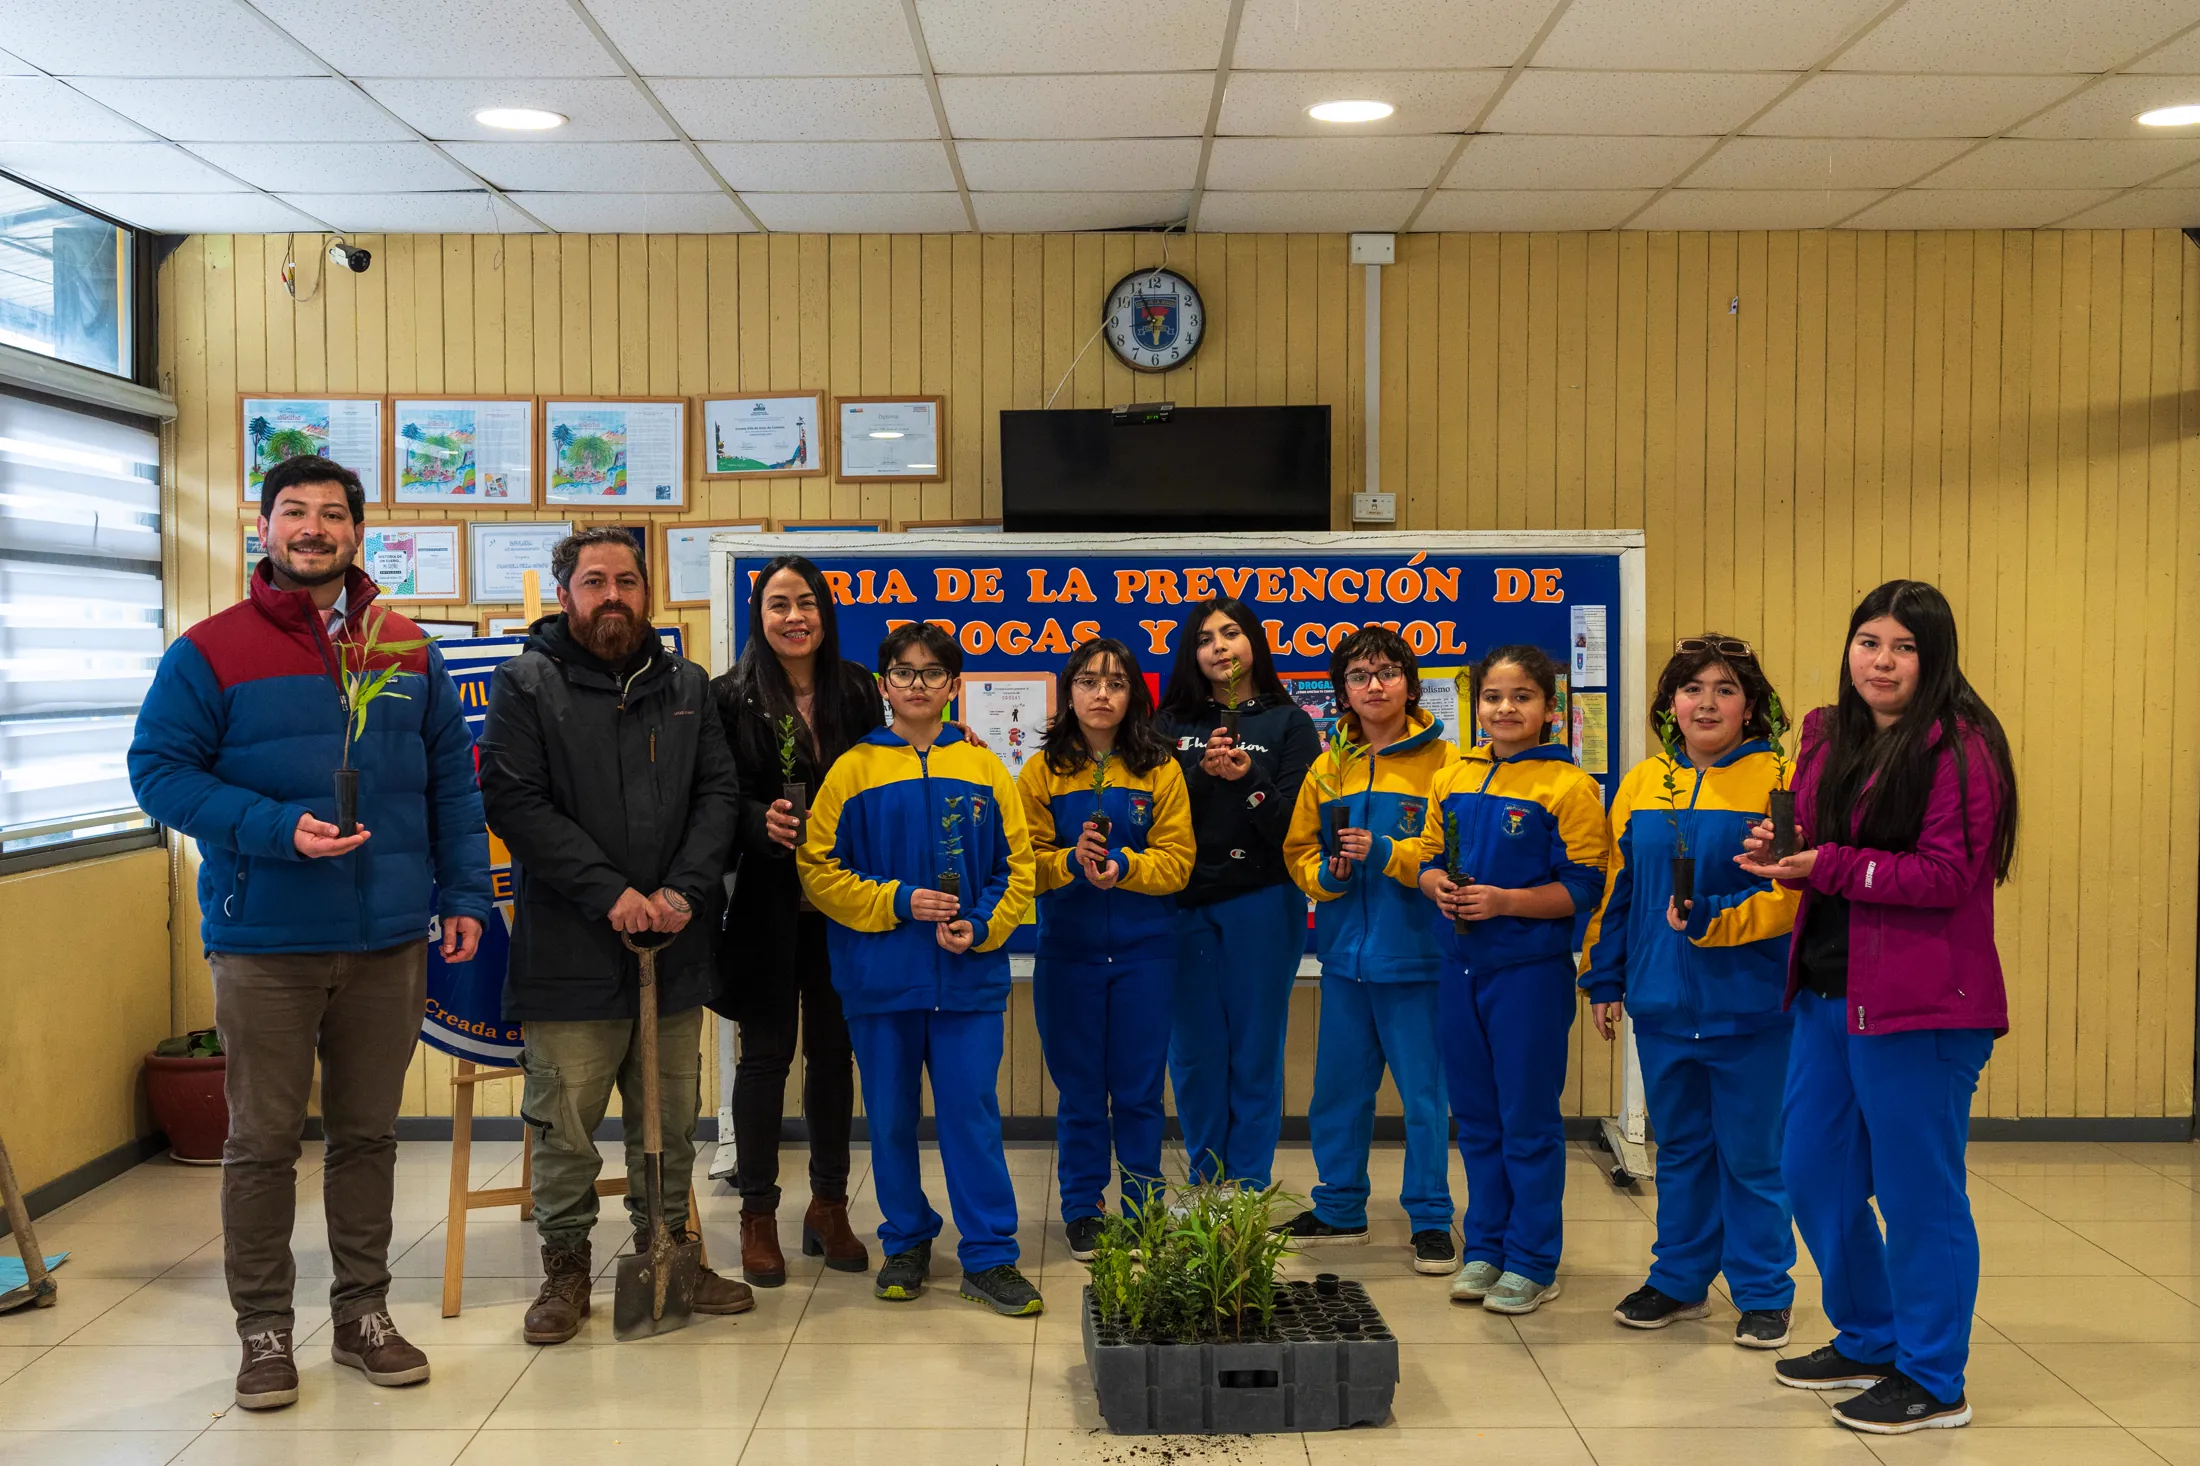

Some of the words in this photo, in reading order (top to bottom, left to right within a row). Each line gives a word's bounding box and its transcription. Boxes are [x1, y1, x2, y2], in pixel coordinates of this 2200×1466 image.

[1148, 277, 1161, 288] 12
[1171, 282, 1177, 293] 1
[1117, 296, 1130, 309] 10
[1184, 295, 1193, 307] 2
[1111, 316, 1119, 328] 9
[1190, 314, 1198, 327] 3
[1117, 335, 1125, 347] 8
[1184, 332, 1193, 344] 4
[1132, 347, 1140, 360] 7
[1171, 347, 1179, 359] 5
[1151, 354, 1160, 366] 6
[933, 568, 1004, 603] DE
[1027, 567, 1097, 603] LA
[1114, 550, 1461, 604] PREVENCIÓN
[1493, 568, 1565, 603] DE
[886, 618, 1101, 655] OGAS
[1139, 619, 1178, 655] Y
[1261, 619, 1467, 657] LCOOL
[425, 998, 497, 1039] Creada
